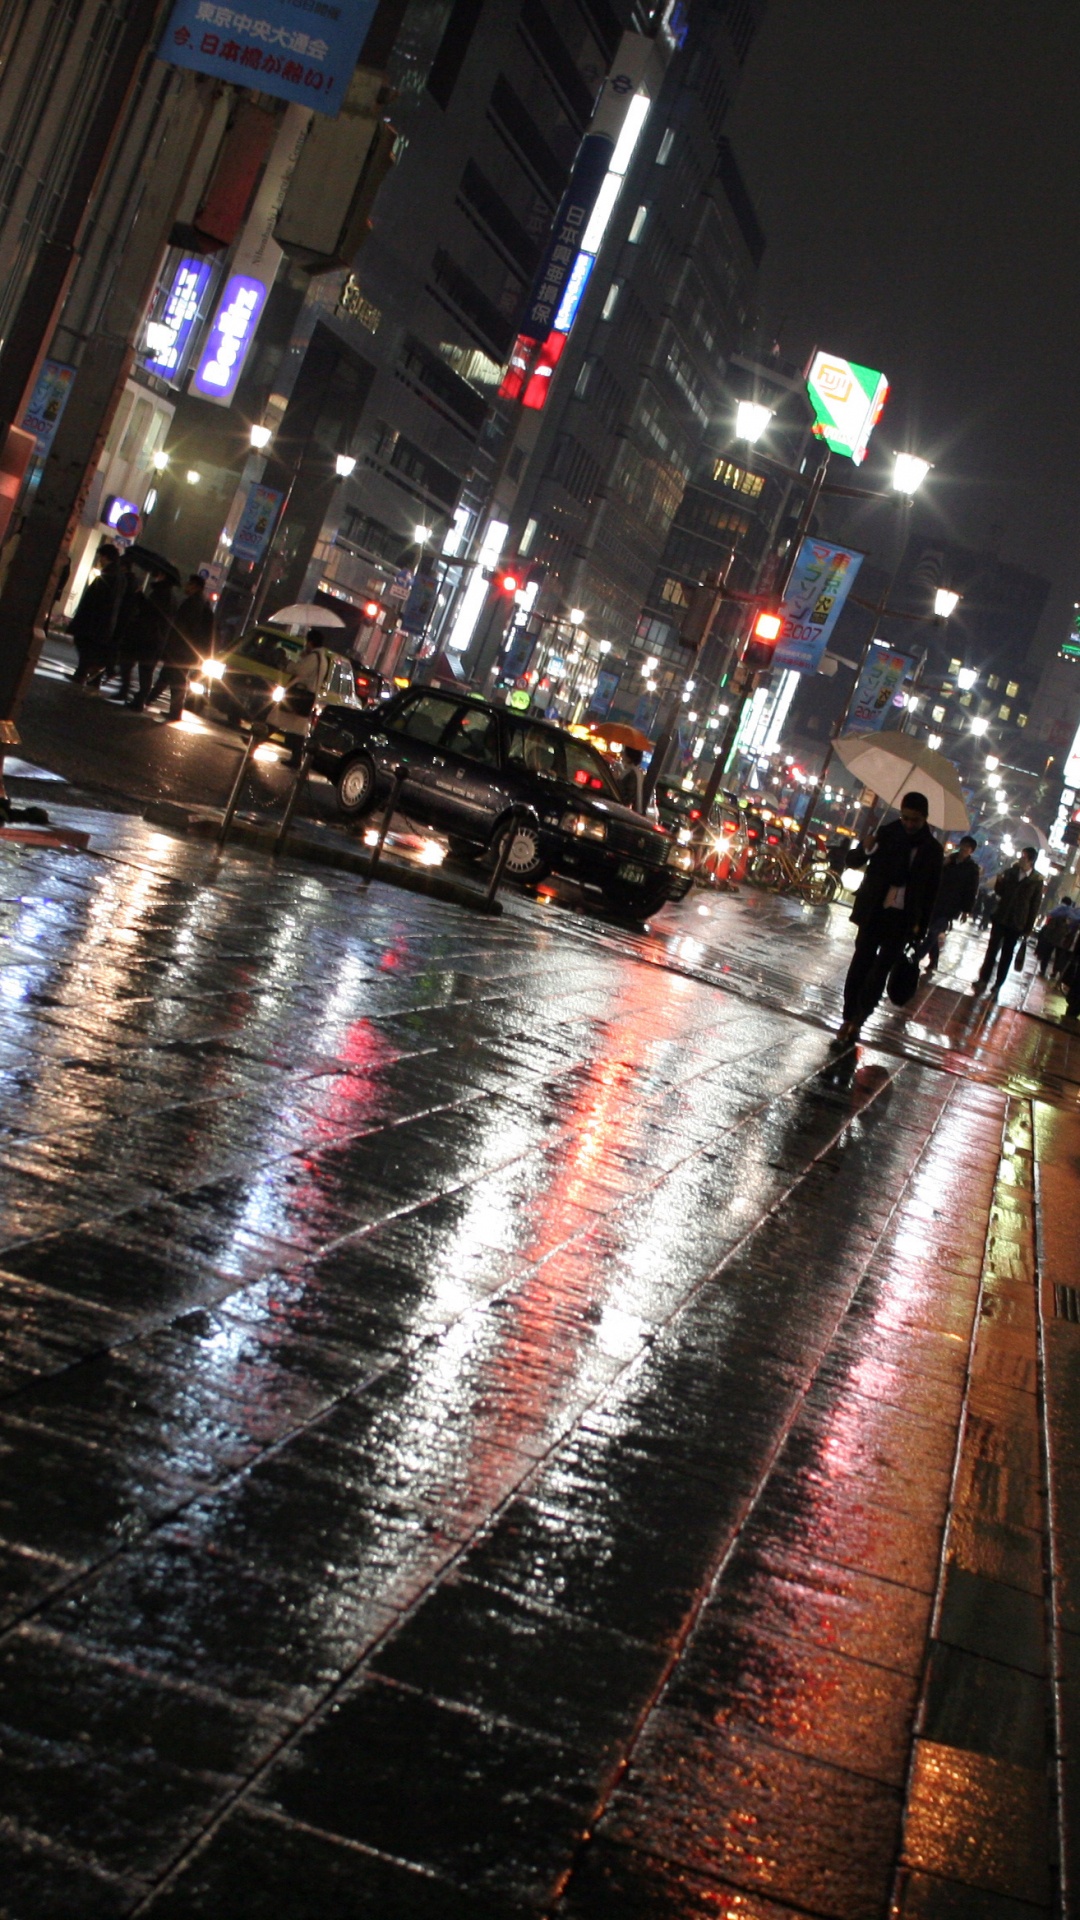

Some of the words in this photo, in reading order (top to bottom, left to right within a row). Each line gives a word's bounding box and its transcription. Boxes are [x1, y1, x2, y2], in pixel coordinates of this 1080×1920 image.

[195, 2, 330, 62] 東京中央大通会
[531, 204, 586, 325] 日本興亜損保
[202, 287, 258, 387] Berlitz
[782, 620, 822, 643] 2007
